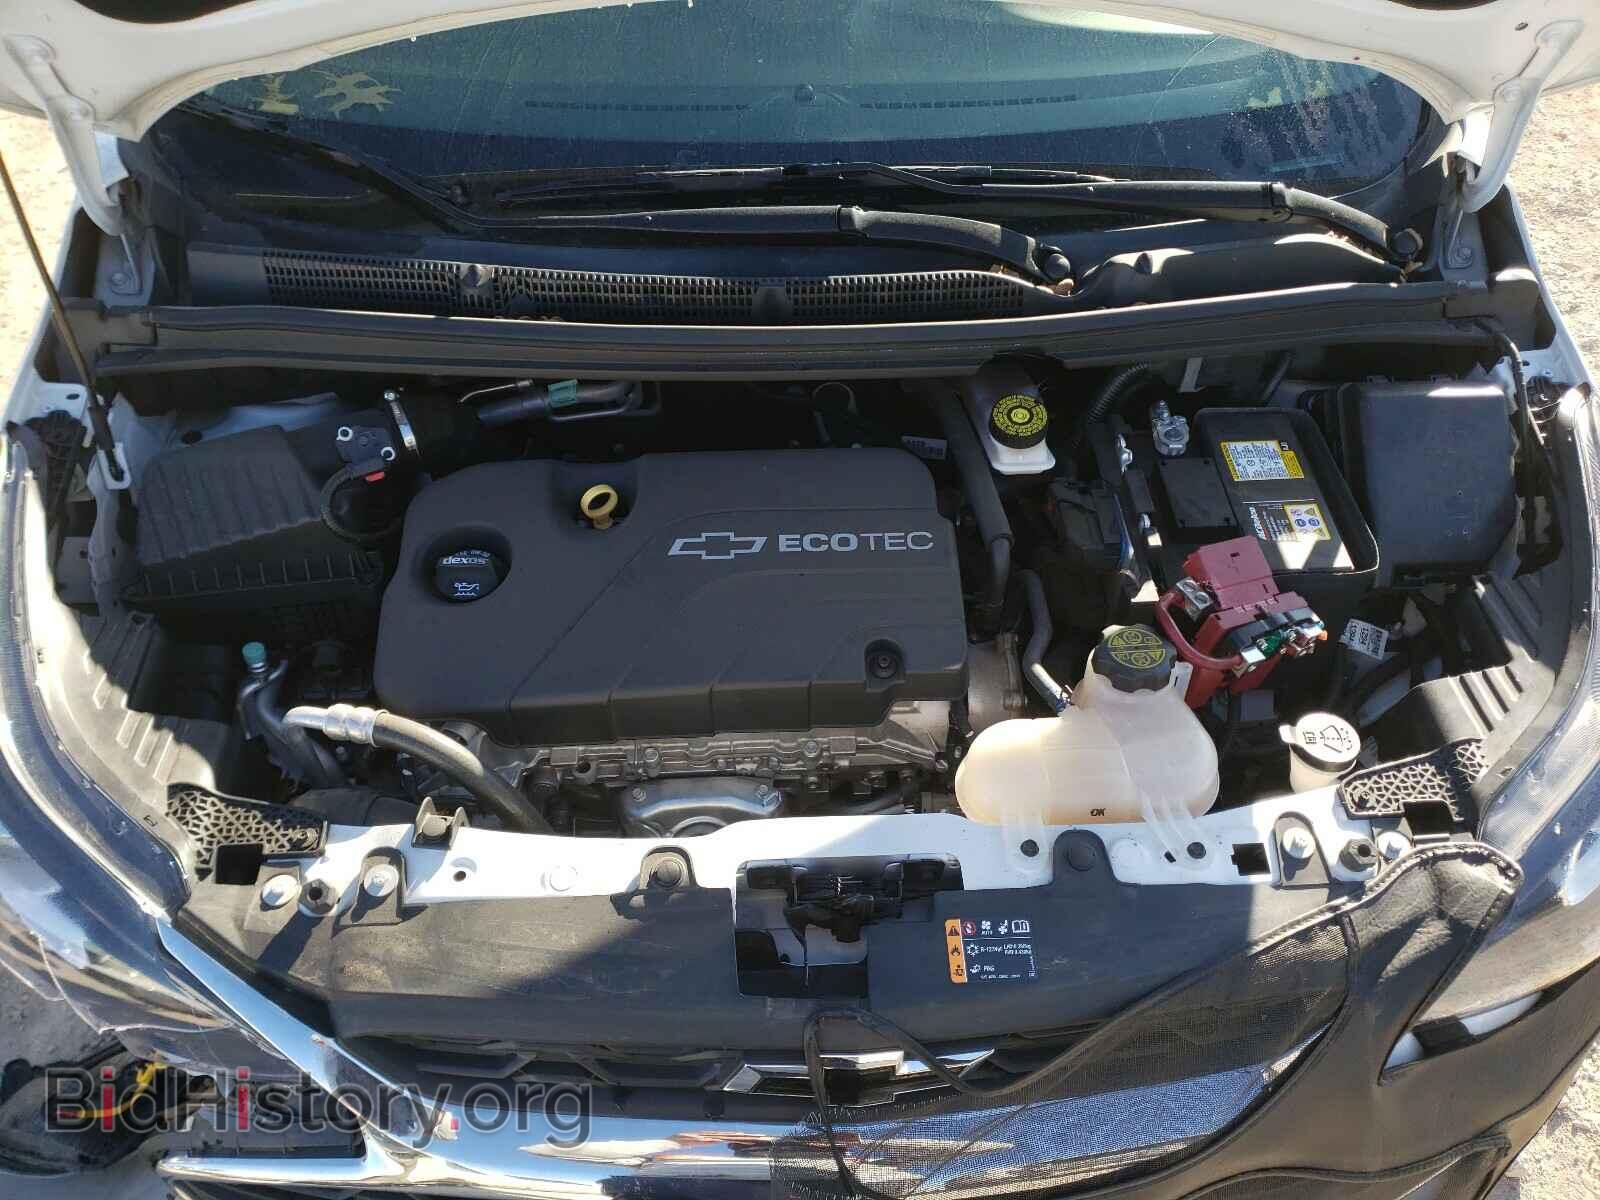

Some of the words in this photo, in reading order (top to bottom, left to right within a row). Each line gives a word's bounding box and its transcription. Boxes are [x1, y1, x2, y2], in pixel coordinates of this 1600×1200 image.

[778, 531, 934, 552] ECOTEC
[442, 555, 489, 565] dexos
[1090, 808, 1106, 817] OK
